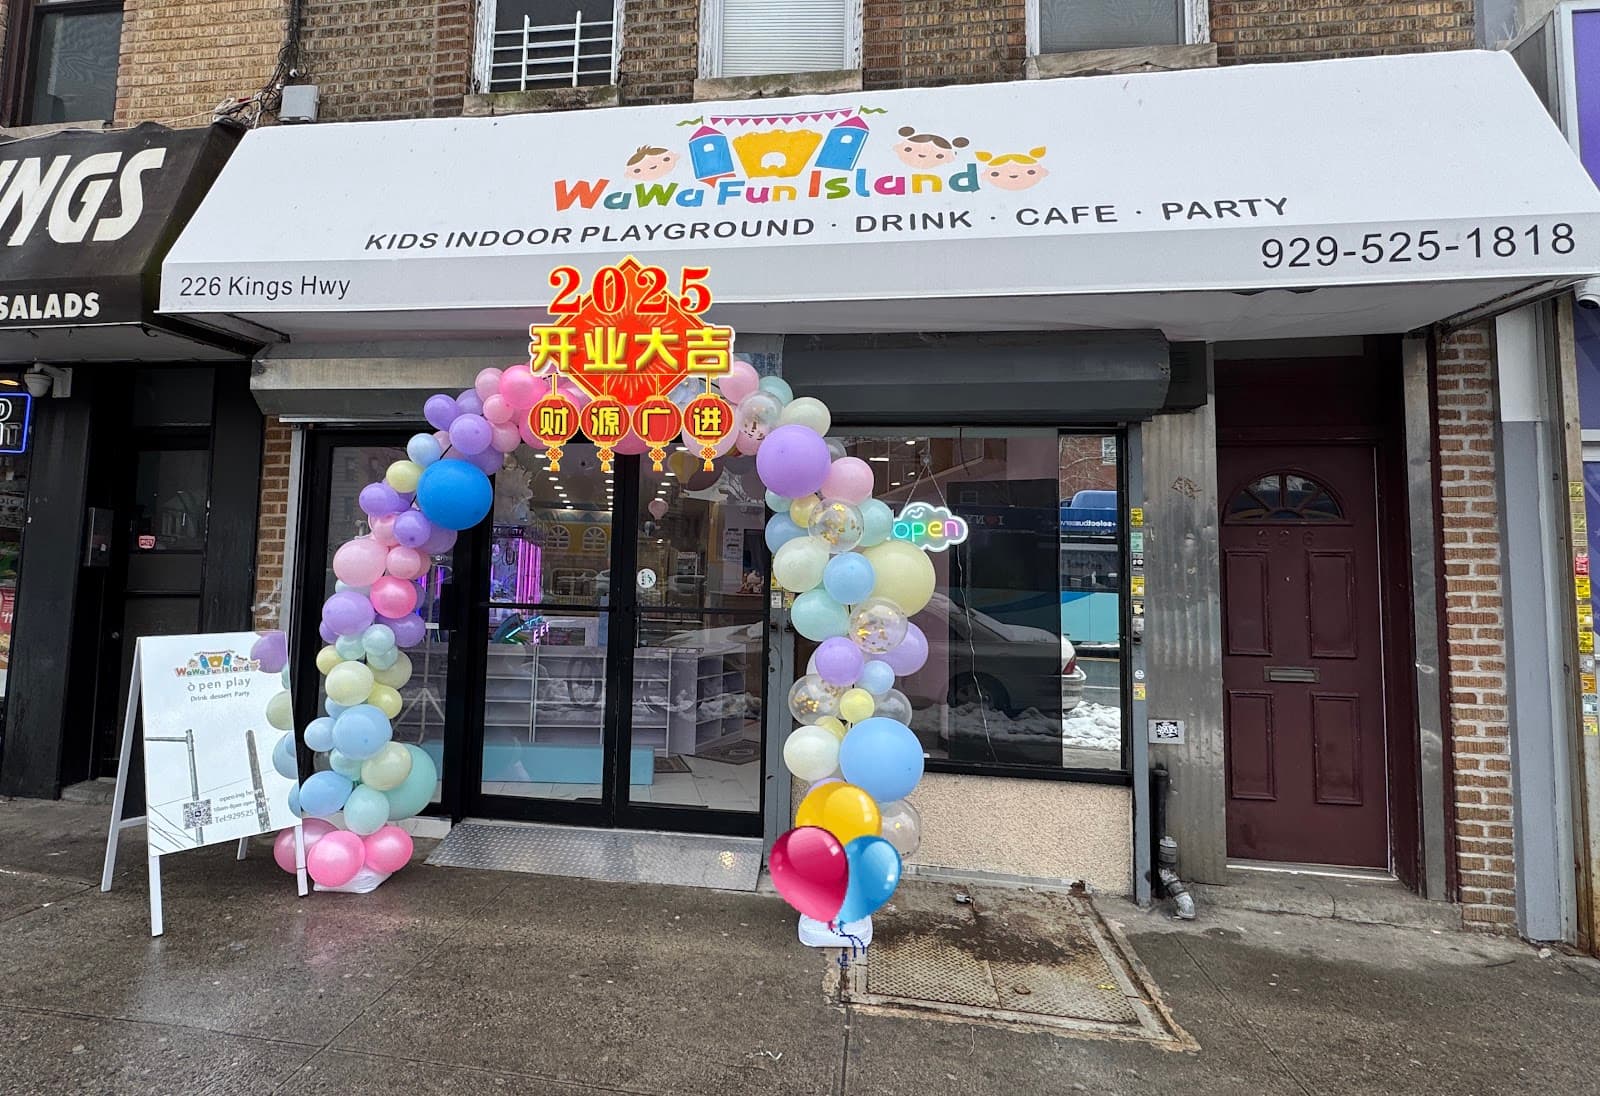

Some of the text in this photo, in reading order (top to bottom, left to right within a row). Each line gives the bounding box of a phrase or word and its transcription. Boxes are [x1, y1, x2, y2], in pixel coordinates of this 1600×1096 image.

[717, 180, 797, 206] Fun
[808, 163, 982, 198] Island
[364, 197, 1288, 250] KIDS INDOOR PLAYGROUND DRINK CAFE PARTY
[1261, 222, 1576, 269] 929-525-1818
[180, 275, 351, 301] 226 Kings Hwy
[893, 519, 959, 543] open
[226, 677, 251, 689] play
